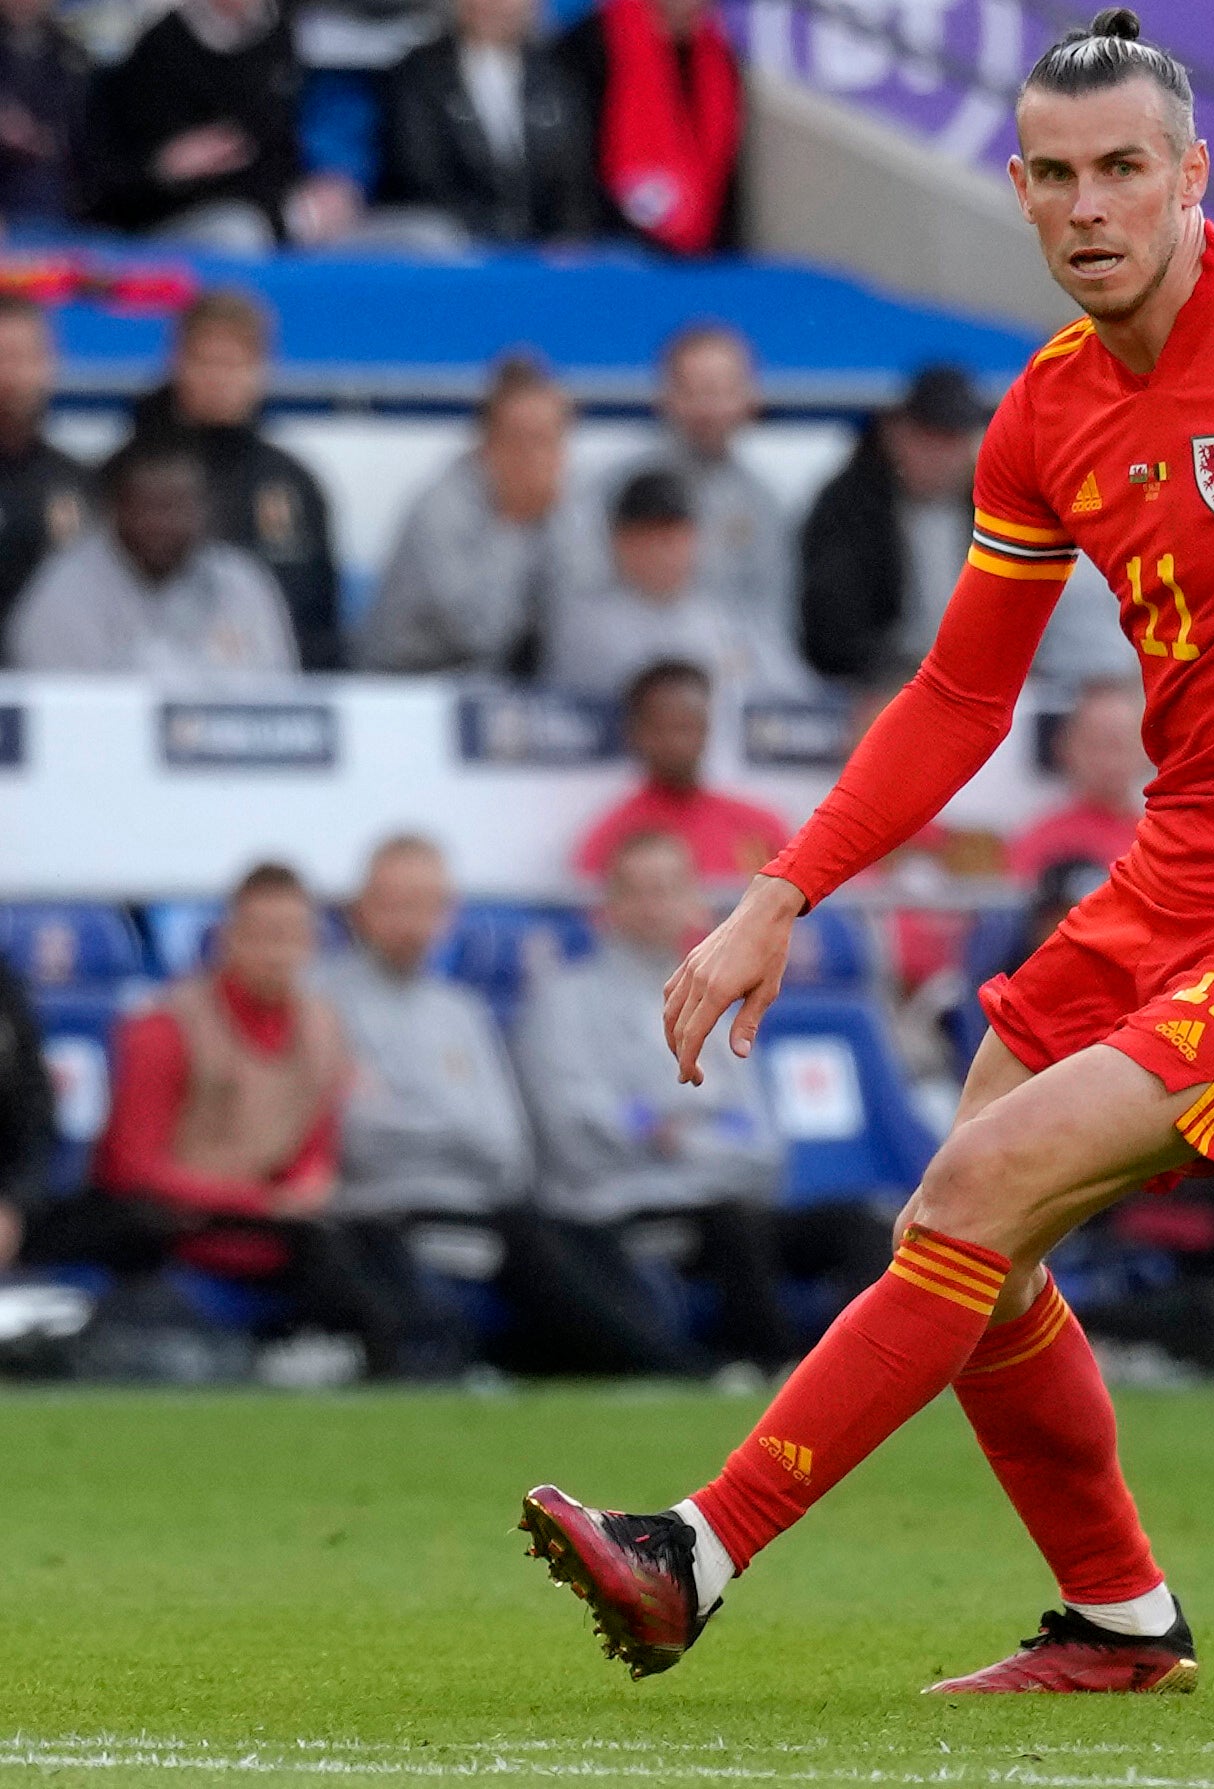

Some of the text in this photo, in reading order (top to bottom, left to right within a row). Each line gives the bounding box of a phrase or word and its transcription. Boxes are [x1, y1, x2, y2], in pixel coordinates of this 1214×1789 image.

[1126, 553, 1200, 661] 11
[1155, 1023, 1197, 1061] adidas
[758, 1436, 812, 1486] adidas
